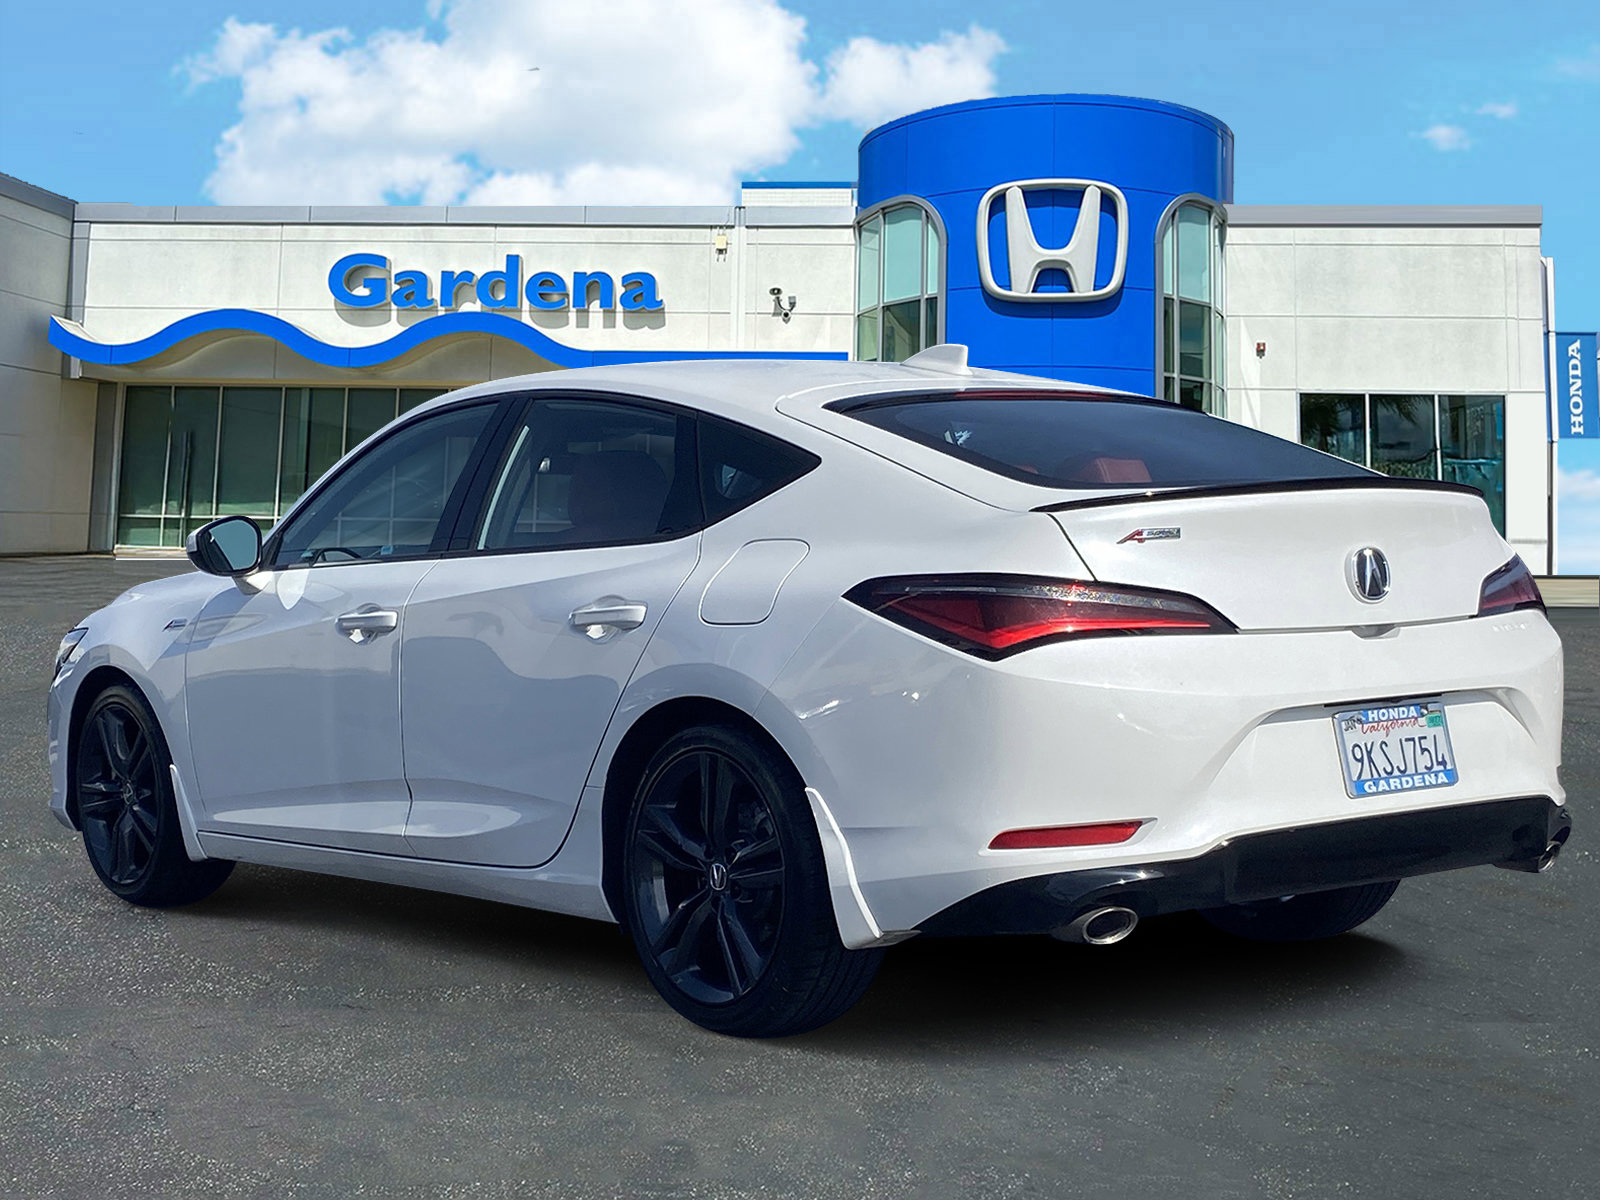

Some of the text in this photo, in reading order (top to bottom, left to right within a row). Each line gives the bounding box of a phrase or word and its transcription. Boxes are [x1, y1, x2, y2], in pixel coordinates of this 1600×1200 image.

[328, 253, 664, 311] Gardena
[1568, 339, 1584, 435] HONDA
[1368, 707, 1418, 721] HONDA
[1351, 734, 1448, 780] 9KSJ754
[1364, 773, 1449, 792] GARDENA
